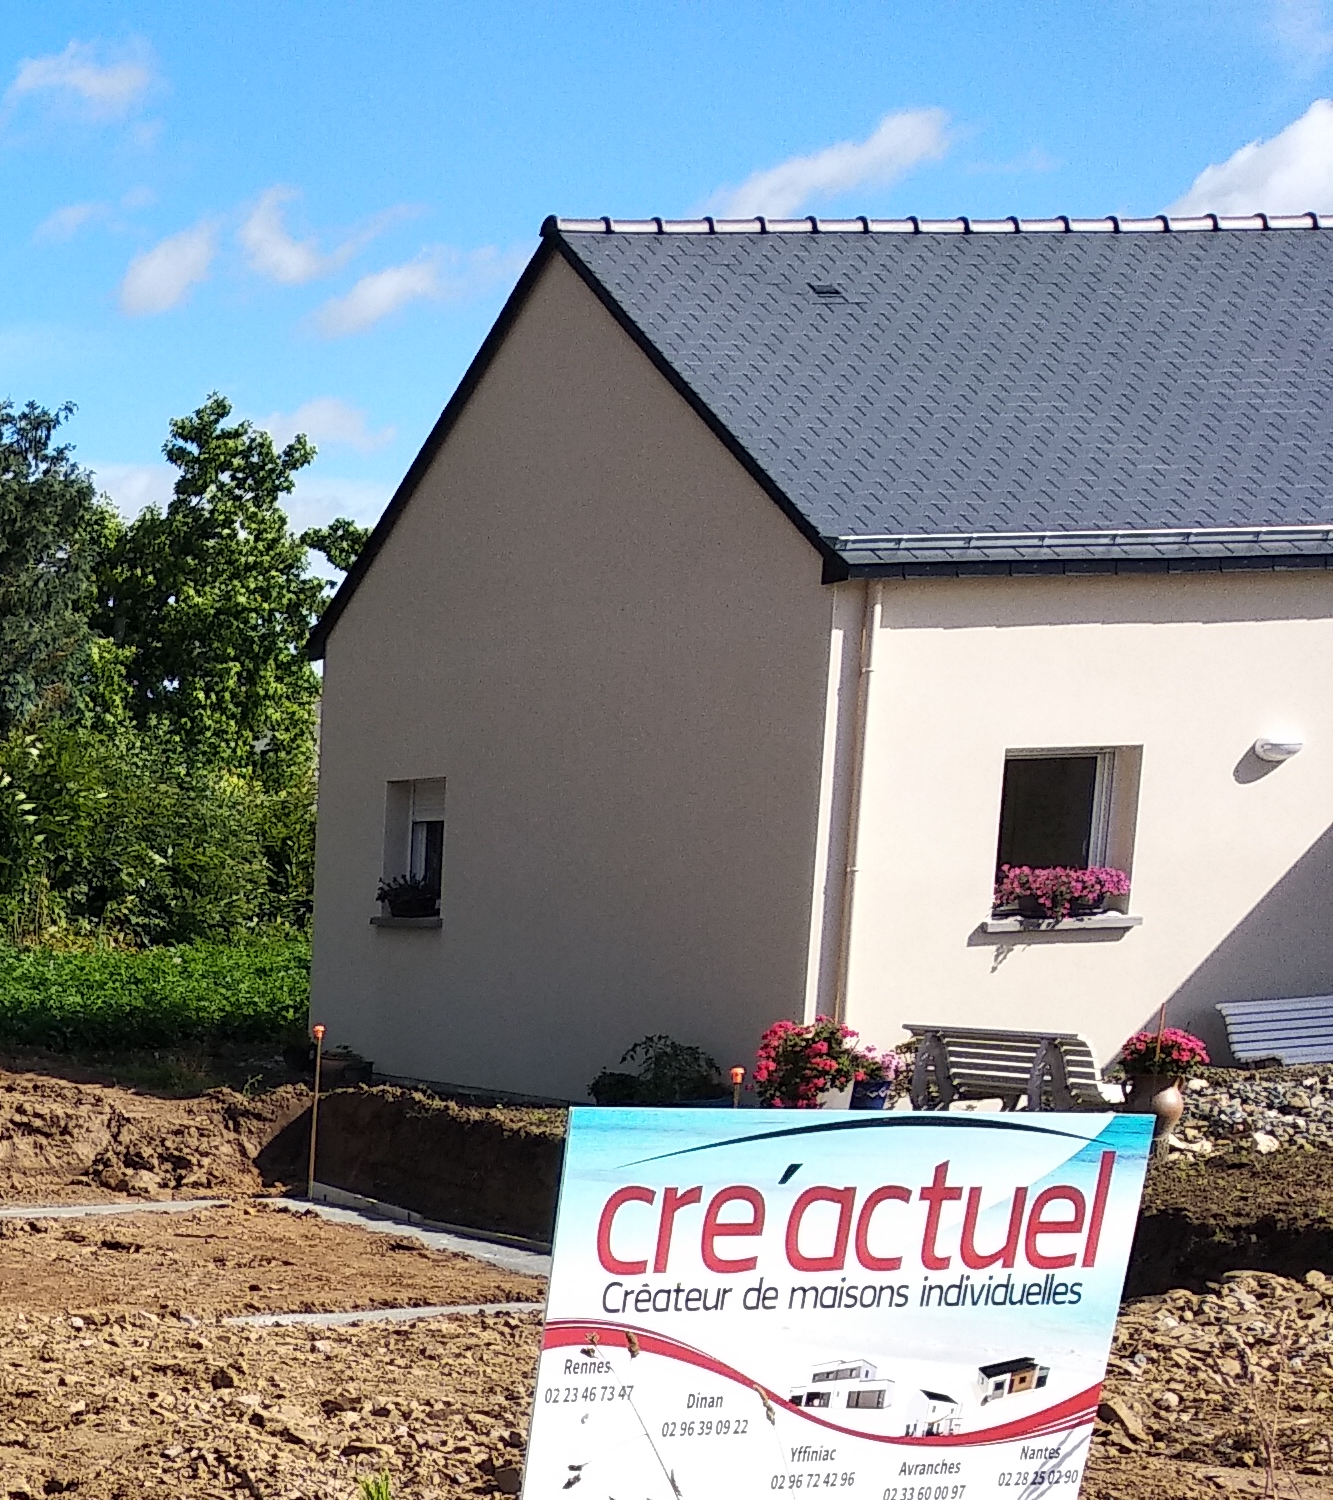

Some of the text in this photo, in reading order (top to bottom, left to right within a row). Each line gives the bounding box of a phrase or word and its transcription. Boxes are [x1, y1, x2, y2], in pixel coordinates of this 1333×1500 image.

[602, 1273, 1083, 1313] Créateur de maisons individuelles
[564, 1359, 611, 1375] Rennes
[544, 1385, 634, 1404] 02 23 46 73 47
[686, 1393, 723, 1409] Dinan
[661, 1419, 749, 1437] 02 96 39 09 22
[790, 1445, 836, 1463] Yffiniac
[1020, 1445, 1061, 1461] Nantes
[898, 1460, 961, 1477] Avranches
[770, 1472, 855, 1490] 02 96 72 42 96
[997, 1469, 1078, 1487] 02 28 25 02 90
[916, 1486, 932, 1500] 60
[933, 1485, 949, 1500] 00
[951, 1485, 966, 1500] 97
